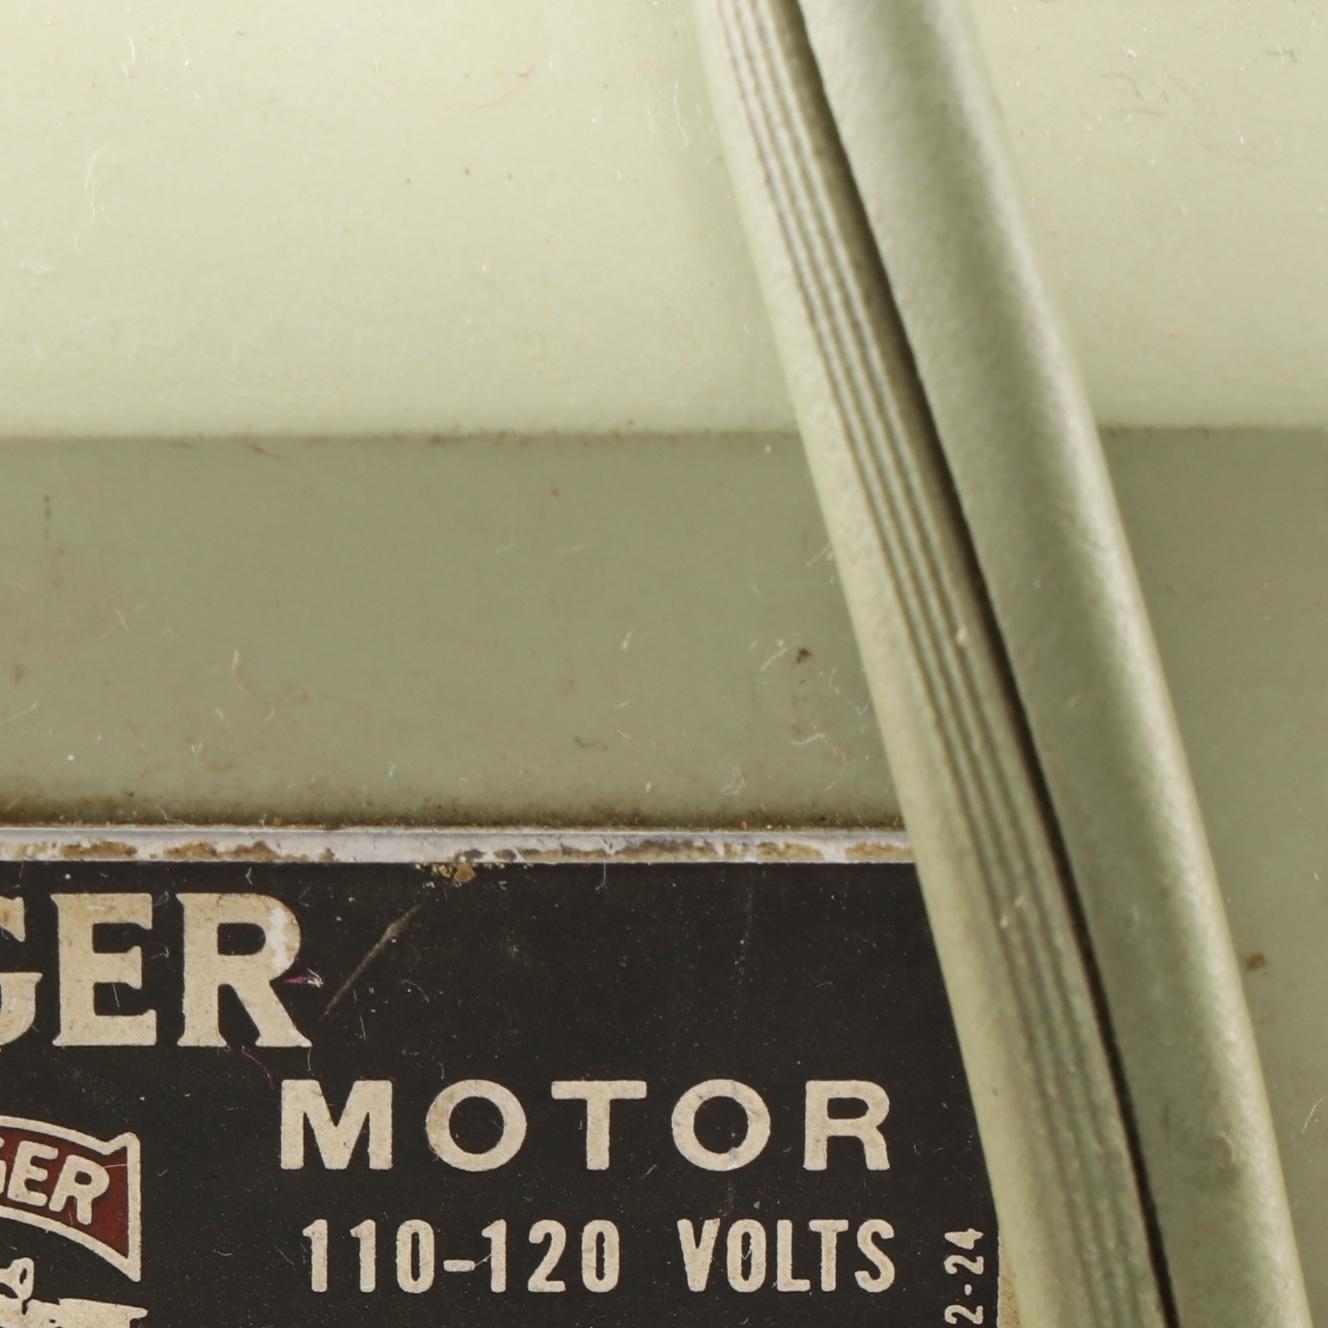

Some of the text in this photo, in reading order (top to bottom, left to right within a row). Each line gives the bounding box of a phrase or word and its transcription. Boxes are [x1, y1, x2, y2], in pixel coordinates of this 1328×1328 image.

[280, 1078, 892, 1173] MOTOR
[302, 1217, 896, 1294] 110-120 VOLTS
